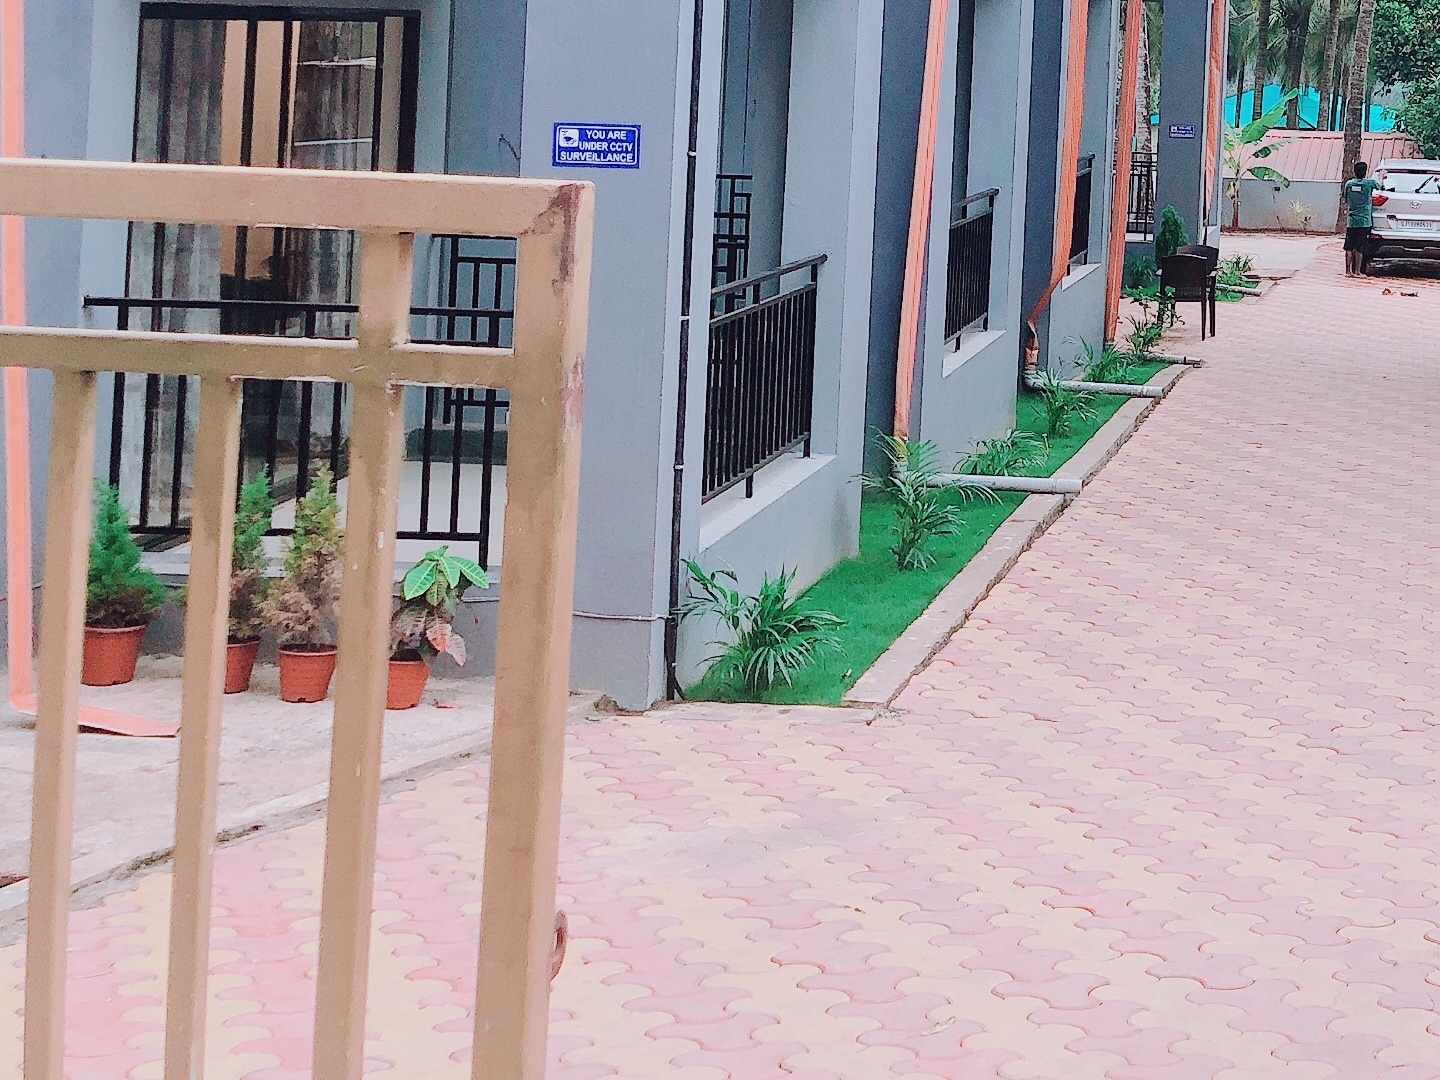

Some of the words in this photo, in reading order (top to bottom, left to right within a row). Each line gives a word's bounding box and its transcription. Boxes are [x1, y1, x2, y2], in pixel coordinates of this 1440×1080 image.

[586, 130, 605, 139] YOU
[607, 130, 627, 140] ARE
[579, 141, 608, 151] UNDER
[609, 142, 633, 152] CCTV
[560, 151, 633, 162] SURVEILLANCE
